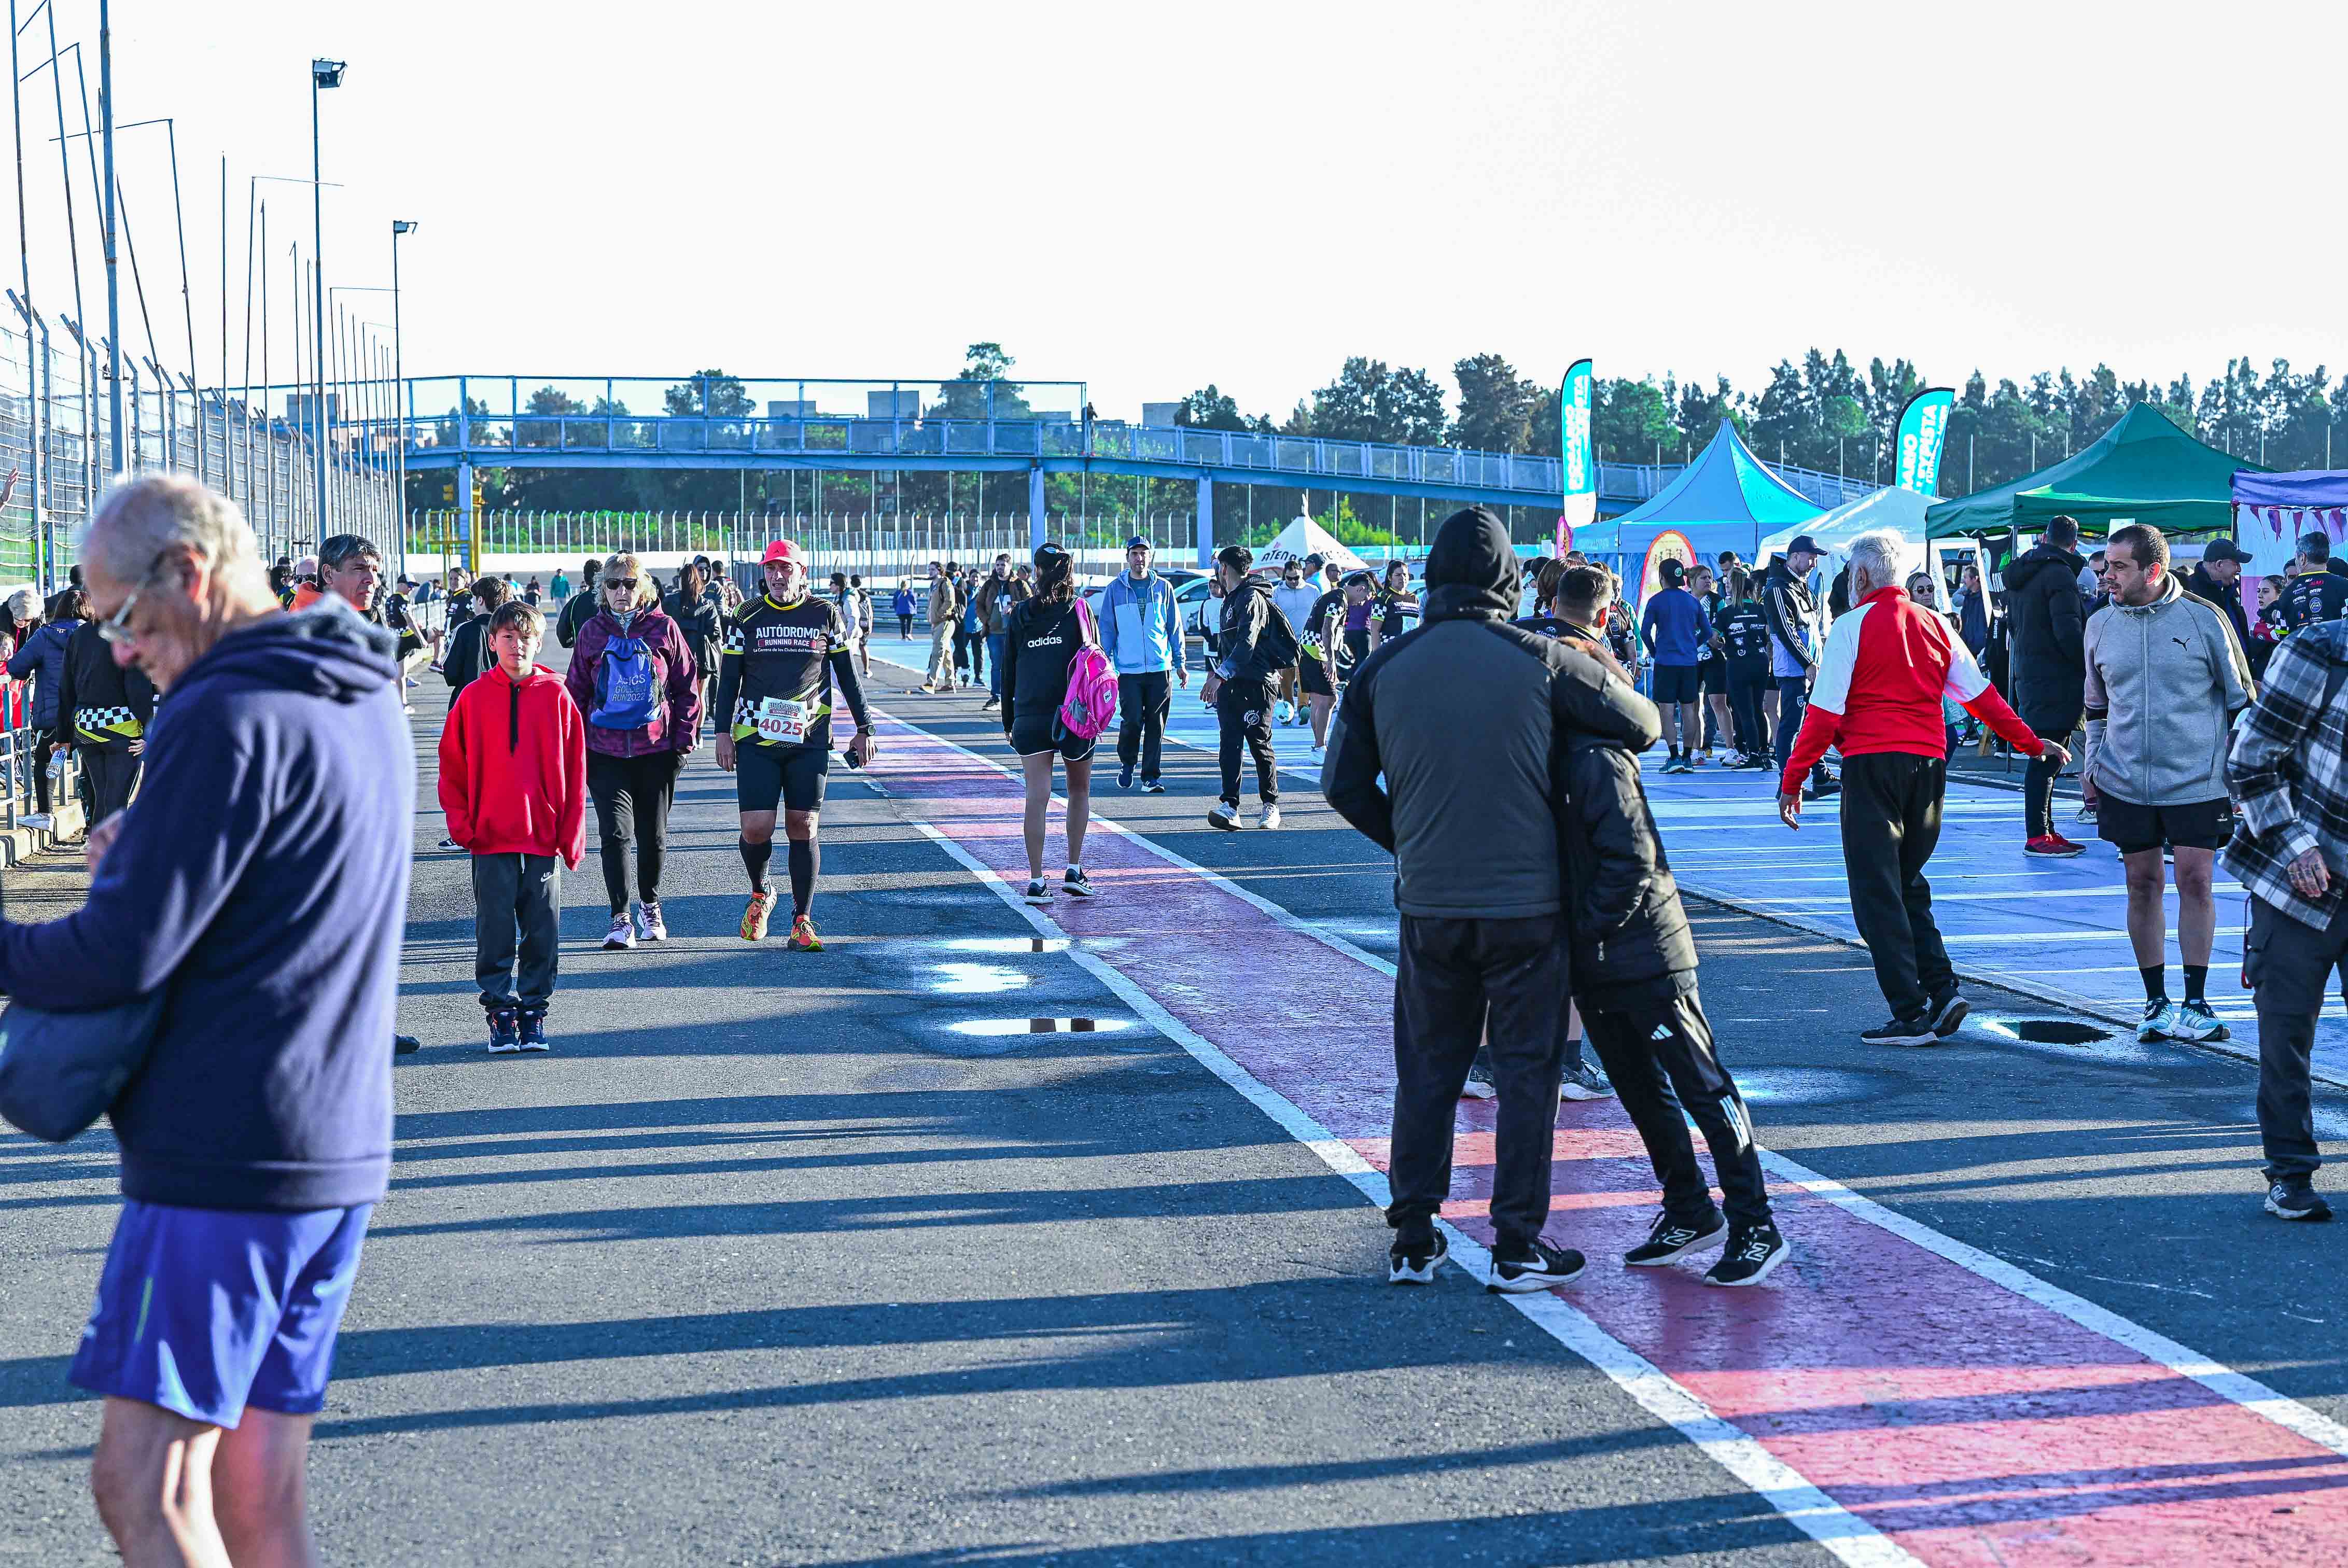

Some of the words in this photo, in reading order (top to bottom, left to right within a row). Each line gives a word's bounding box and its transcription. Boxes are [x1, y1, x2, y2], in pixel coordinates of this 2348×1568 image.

[1261, 550, 1302, 562] ATENA
[756, 624, 819, 639] AUTÓDROMO
[1027, 636, 1063, 648] adidas
[616, 674, 646, 685] ASICS
[768, 702, 801, 713] AUTÓDROMO
[759, 718, 803, 735] 4025
